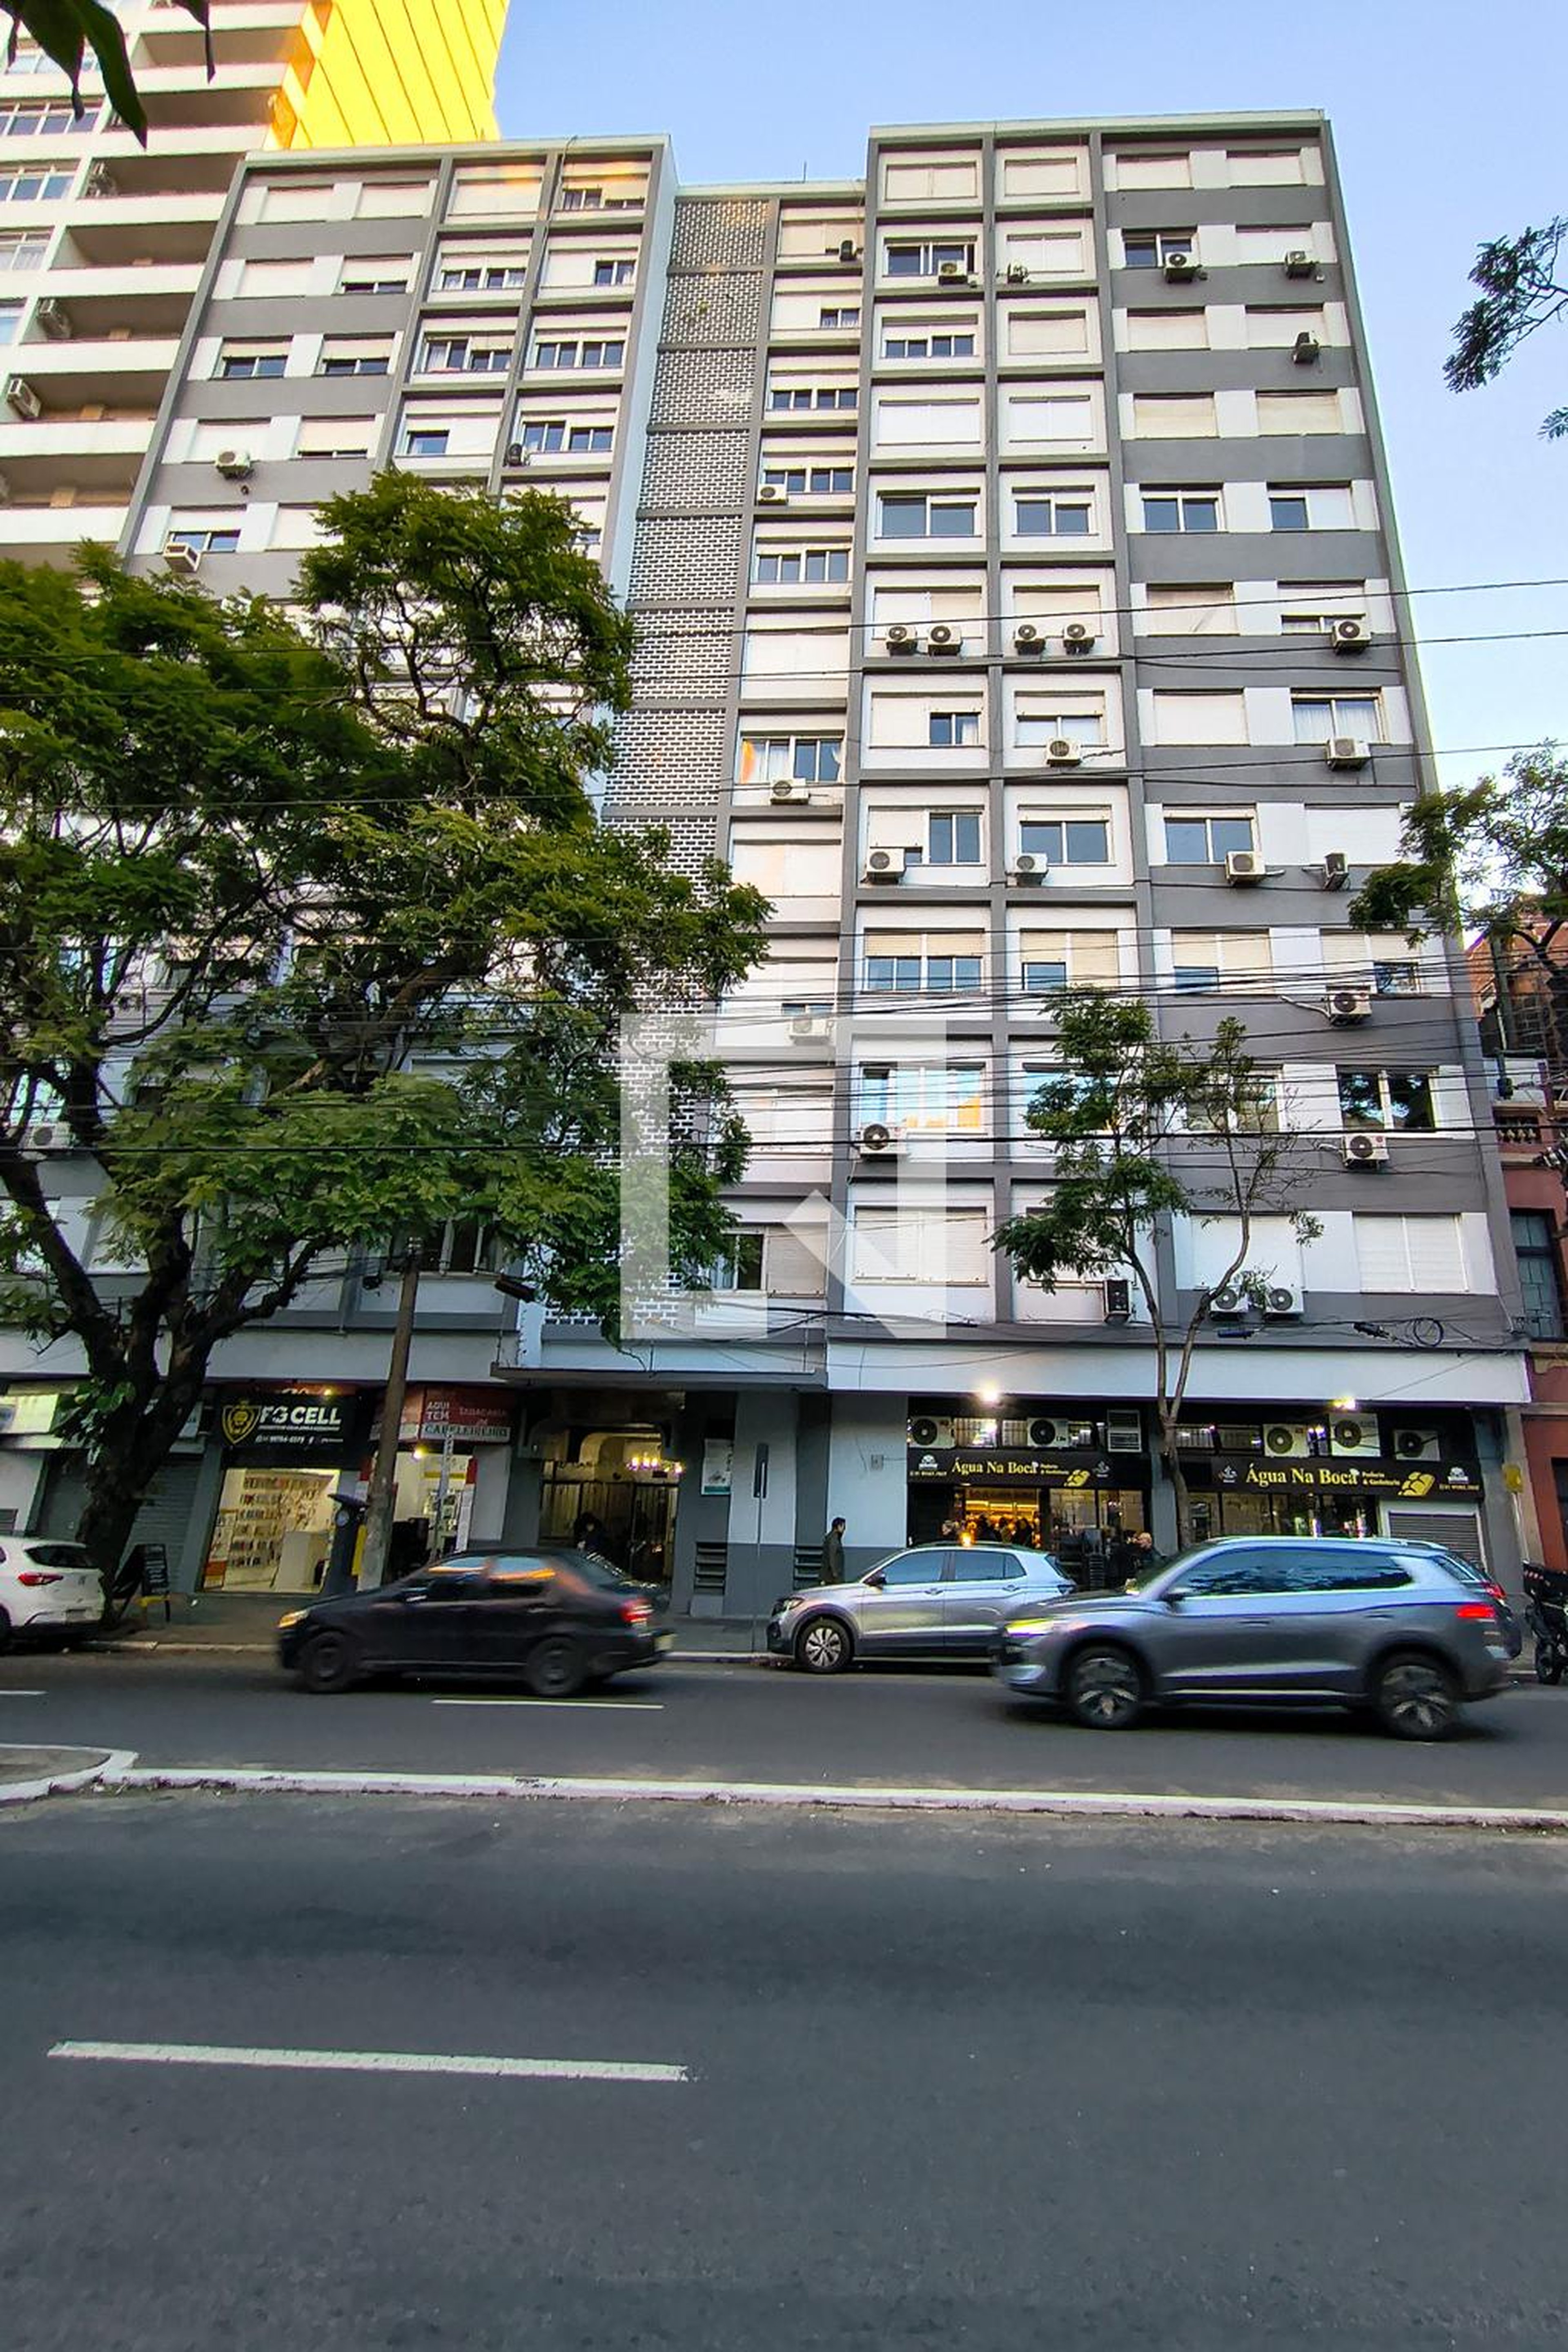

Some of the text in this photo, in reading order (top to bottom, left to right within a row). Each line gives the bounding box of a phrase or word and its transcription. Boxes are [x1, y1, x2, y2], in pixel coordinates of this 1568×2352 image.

[426, 1401, 449, 1410] AQUI
[290, 1407, 342, 1425] CELL
[951, 1457, 984, 1475] Água
[987, 1461, 1004, 1474] Na
[1008, 1461, 1038, 1474] Boca
[1246, 1463, 1358, 1487] Água Na Boca
